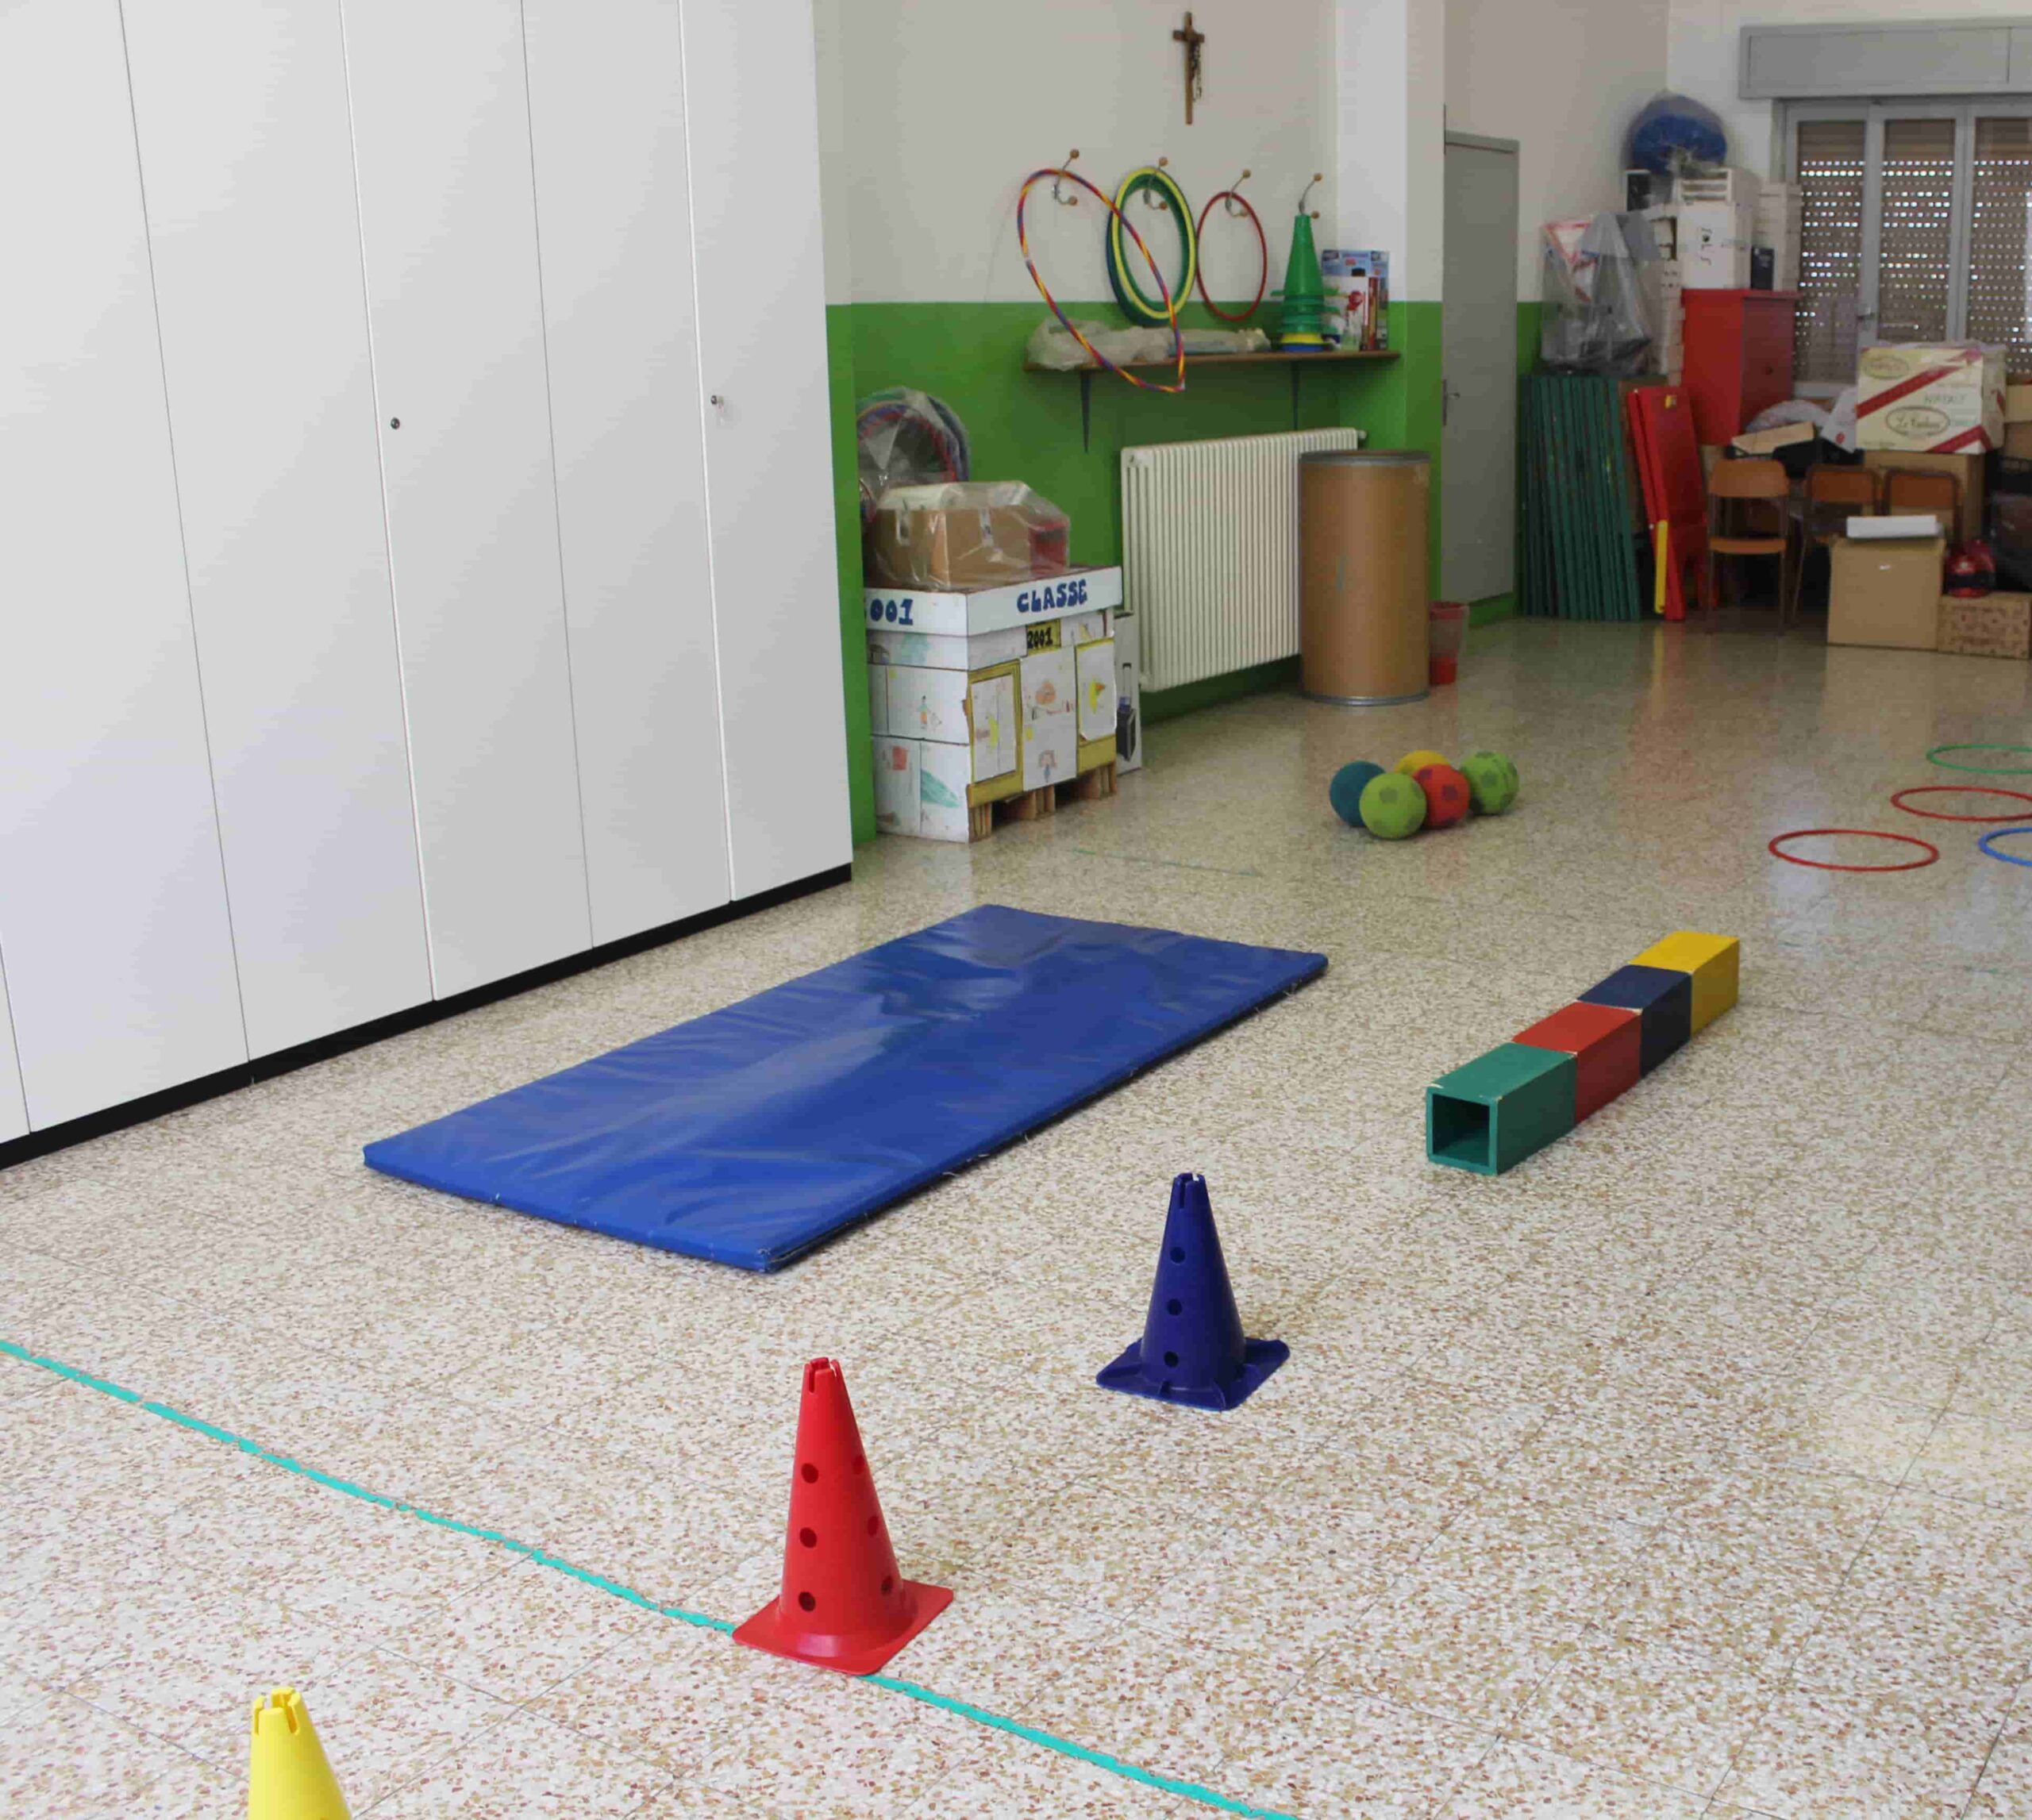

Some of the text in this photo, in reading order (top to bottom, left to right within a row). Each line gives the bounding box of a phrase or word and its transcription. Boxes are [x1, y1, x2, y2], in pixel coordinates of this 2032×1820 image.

[1017, 579, 1087, 613] CLASSE
[868, 598, 914, 625] 001
[1026, 626, 1054, 649] 2001
